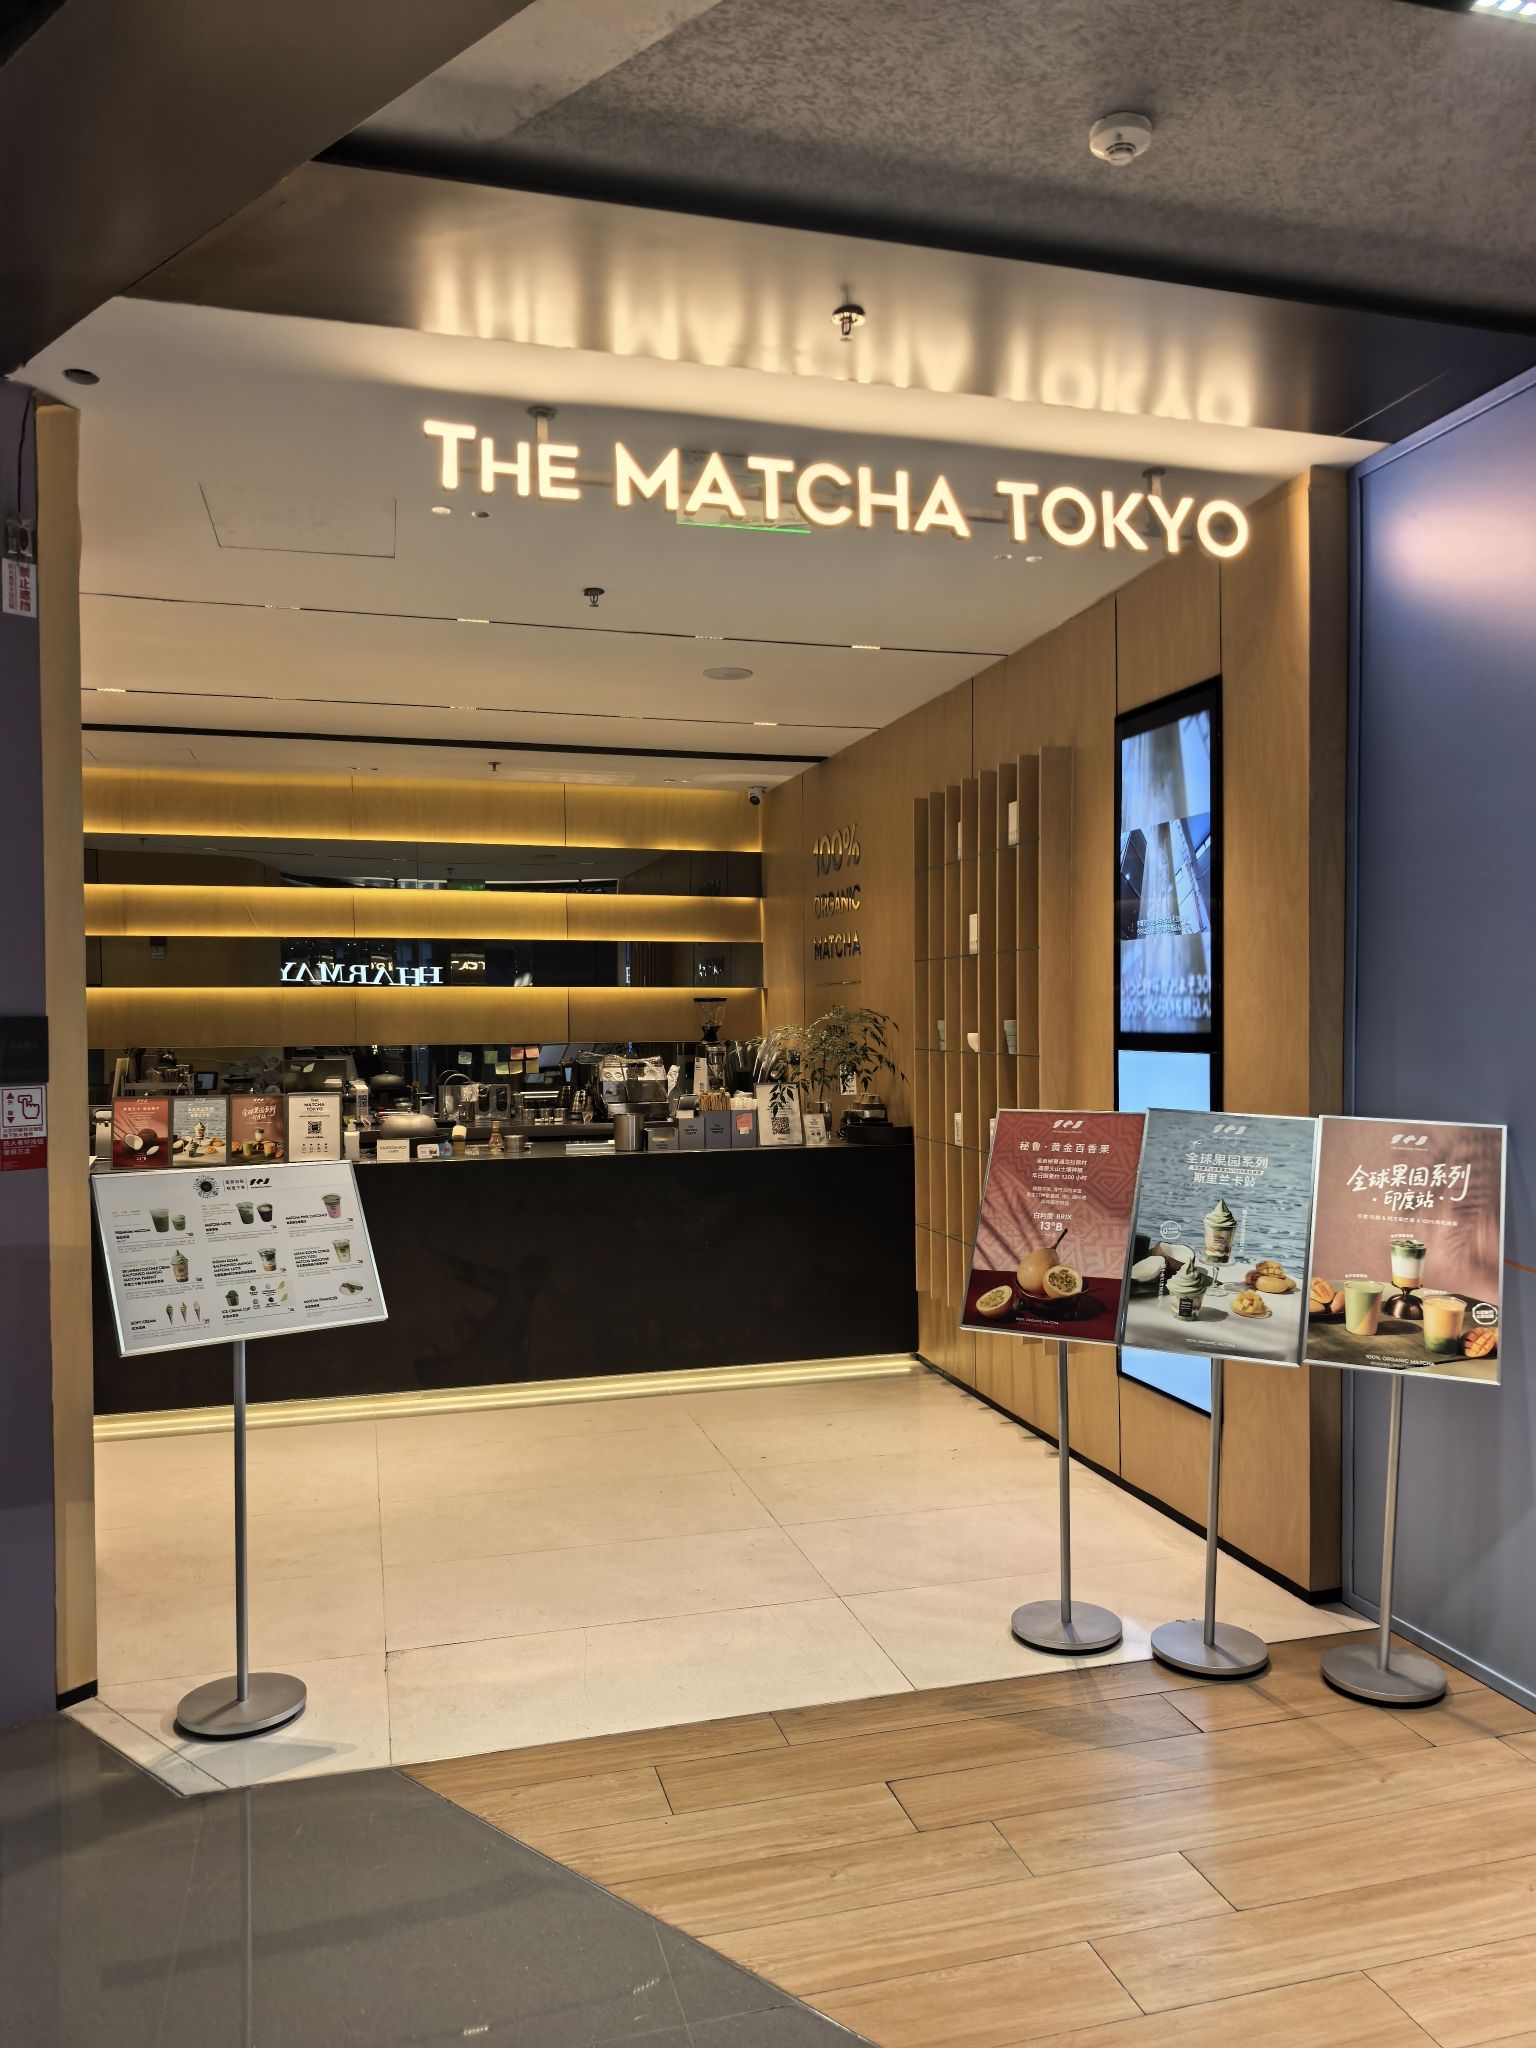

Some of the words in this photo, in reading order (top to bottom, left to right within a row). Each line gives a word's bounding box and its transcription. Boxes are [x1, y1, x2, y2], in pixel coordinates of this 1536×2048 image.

[423, 419, 581, 502] THE
[614, 441, 973, 541] MATCHA
[996, 480, 1252, 560] TOKYO
[813, 823, 861, 876] 100%
[814, 884, 861, 919] ORGANIC
[813, 930, 861, 961] MATCHA
[1185, 1152, 1268, 1168] 全球果园系列
[1193, 1172, 1256, 1187] 斯里兰卡站
[1347, 1163, 1471, 1201] 全球果园系列
[1382, 1356, 1409, 1364] ORGANIC
